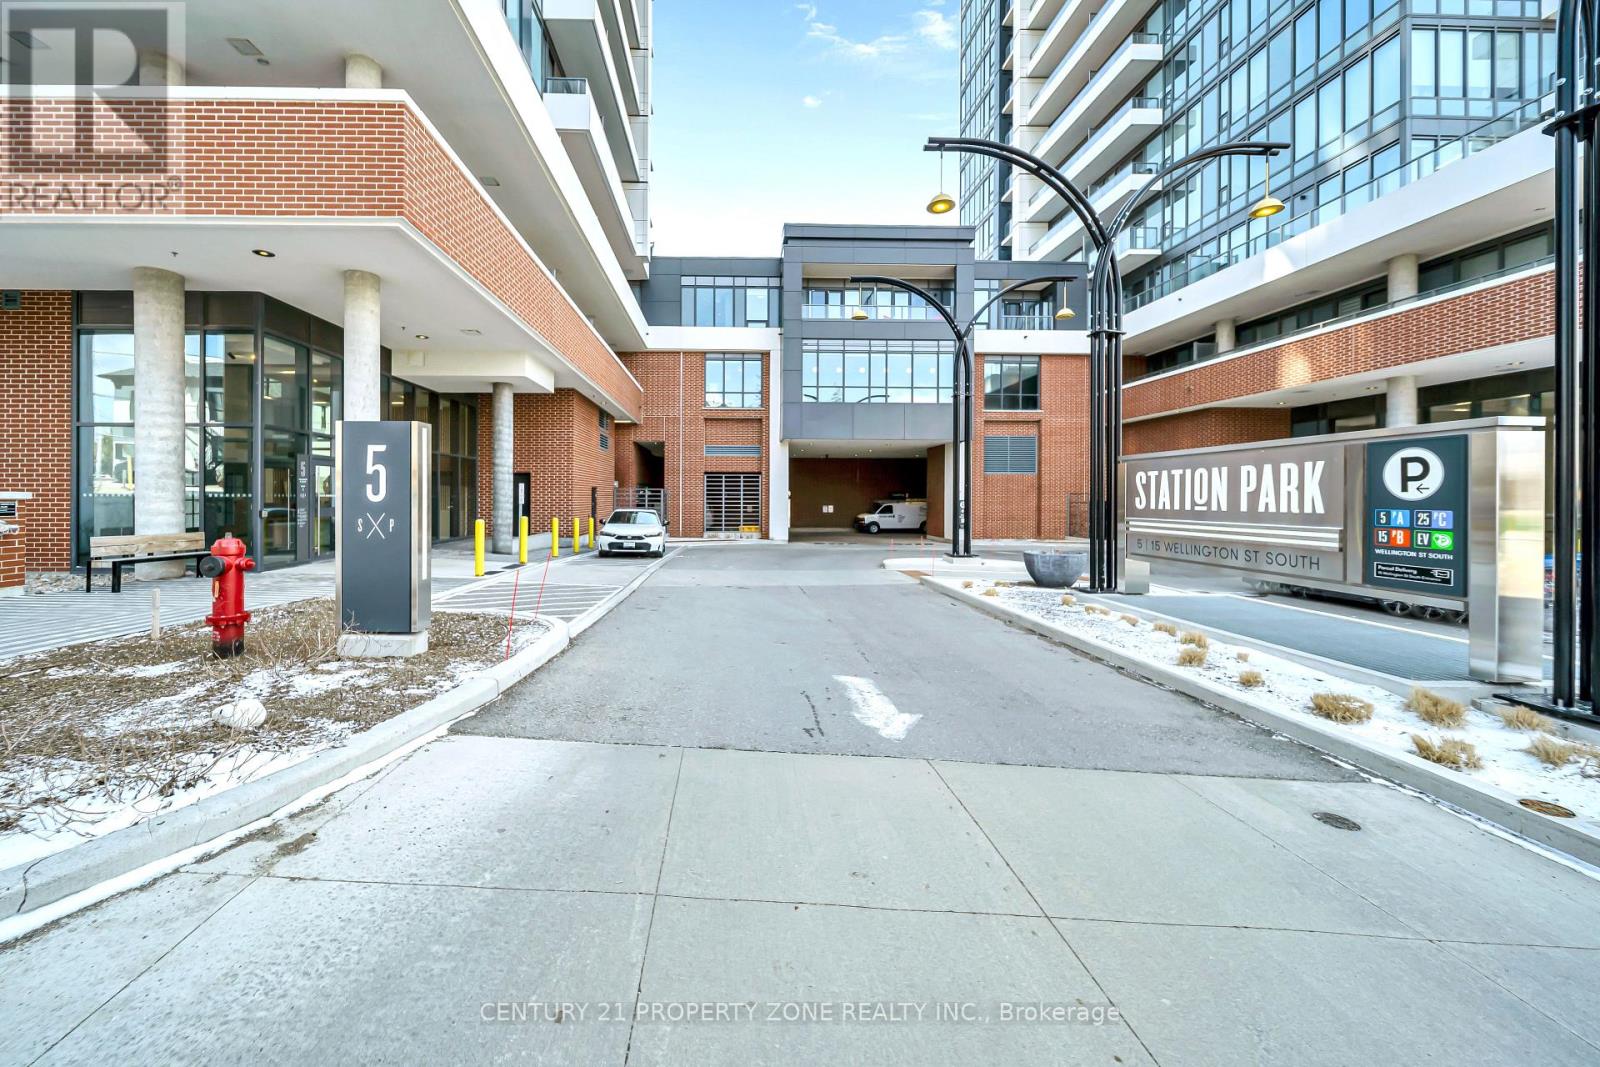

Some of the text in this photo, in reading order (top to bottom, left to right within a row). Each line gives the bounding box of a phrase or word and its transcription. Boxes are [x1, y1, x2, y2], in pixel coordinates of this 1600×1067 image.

[366, 444, 387, 503] 5
[1400, 457, 1430, 493] P
[1134, 460, 1326, 514] STATION PARK
[1380, 511, 1387, 524] 5
[1417, 512, 1430, 526] 25
[1378, 530, 1388, 543] 15
[1417, 533, 1430, 546] EV
[1136, 538, 1321, 571] 5 15 WELLINGTON ST SOUTH
[1374, 548, 1417, 557] WELLINGTON
